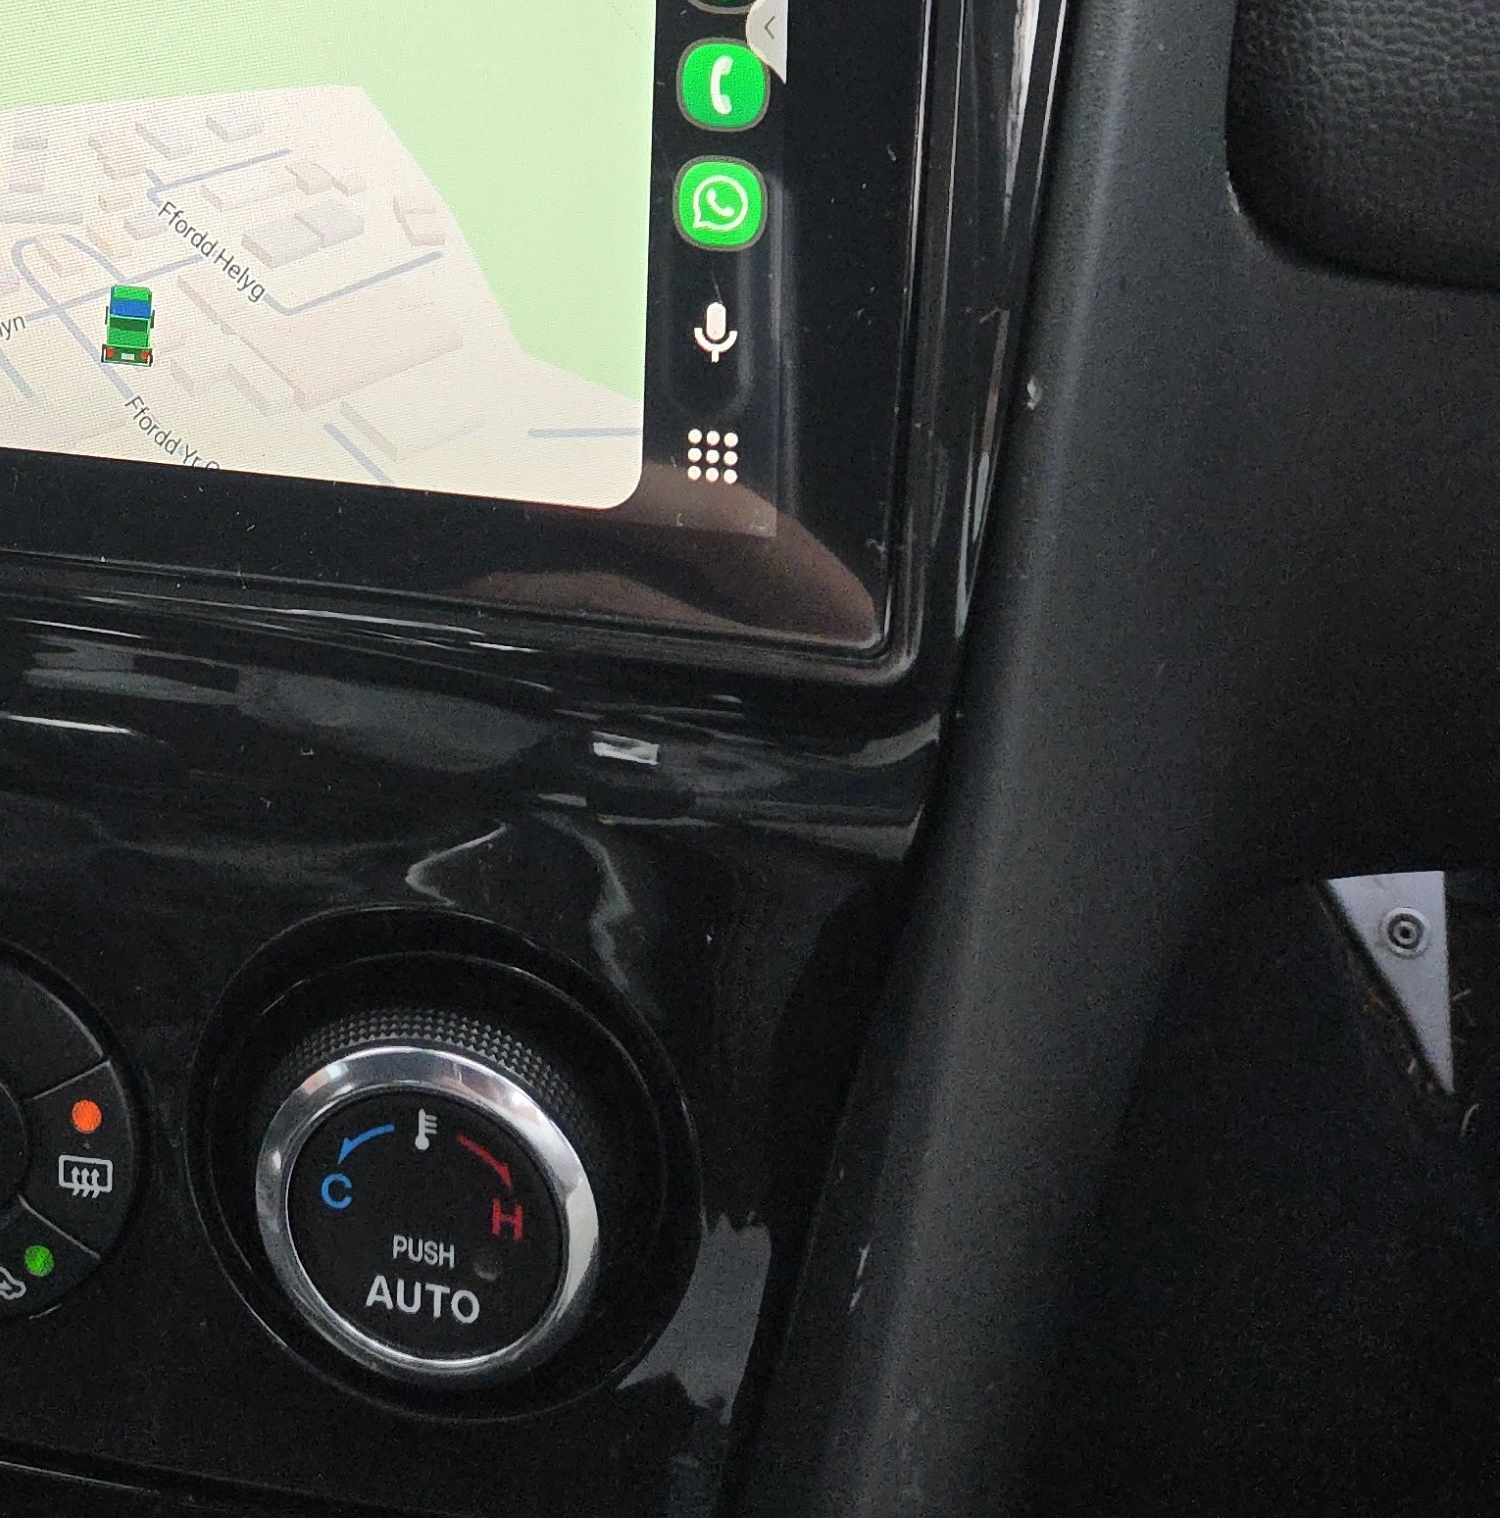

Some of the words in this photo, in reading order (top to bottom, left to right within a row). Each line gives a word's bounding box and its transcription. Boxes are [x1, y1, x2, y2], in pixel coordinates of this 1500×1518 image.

[157, 200, 219, 258] Ffordd
[212, 247, 266, 303] Helyg
[123, 395, 183, 456] Ffordd
[320, 1173, 352, 1209] C
[491, 1196, 524, 1242] H
[392, 1234, 456, 1269] PUSH
[365, 1275, 480, 1324] AUTO
